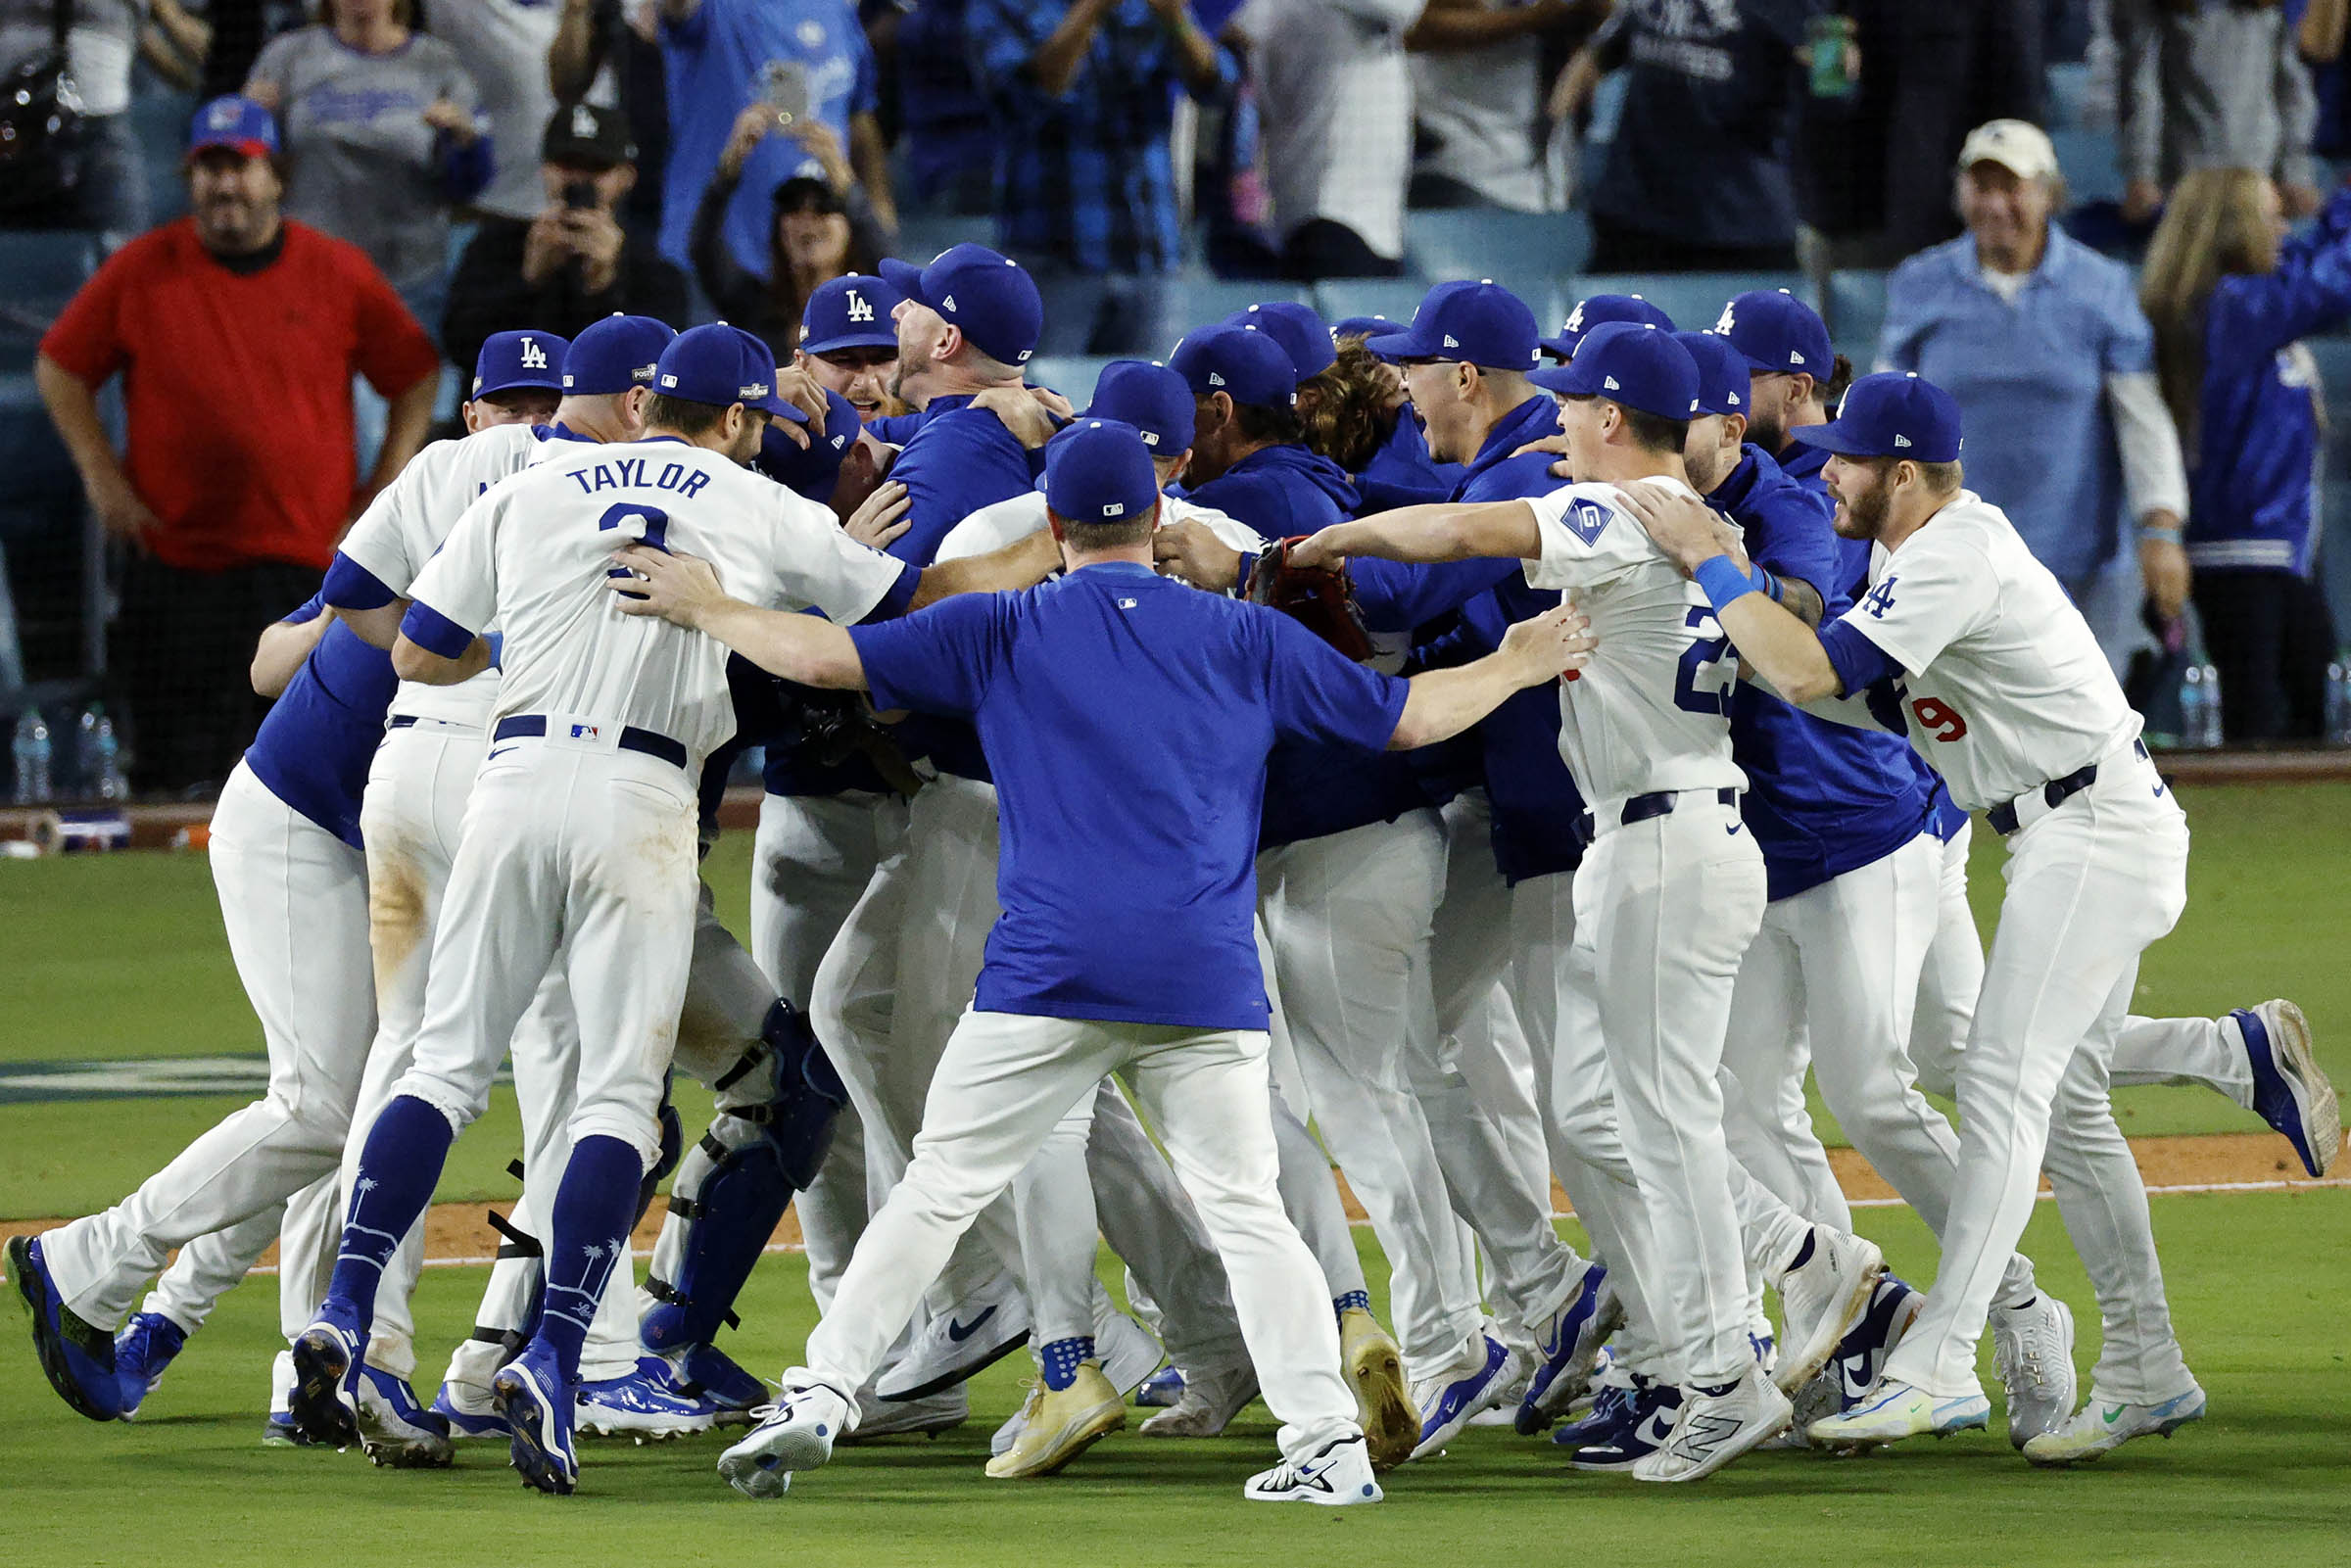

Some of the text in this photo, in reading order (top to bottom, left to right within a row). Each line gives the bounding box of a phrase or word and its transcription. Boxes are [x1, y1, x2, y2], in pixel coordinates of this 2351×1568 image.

[845, 290, 875, 322] LA
[520, 337, 548, 368] LA
[565, 458, 711, 499] TAYLOR
[1911, 696, 1968, 742] 9
